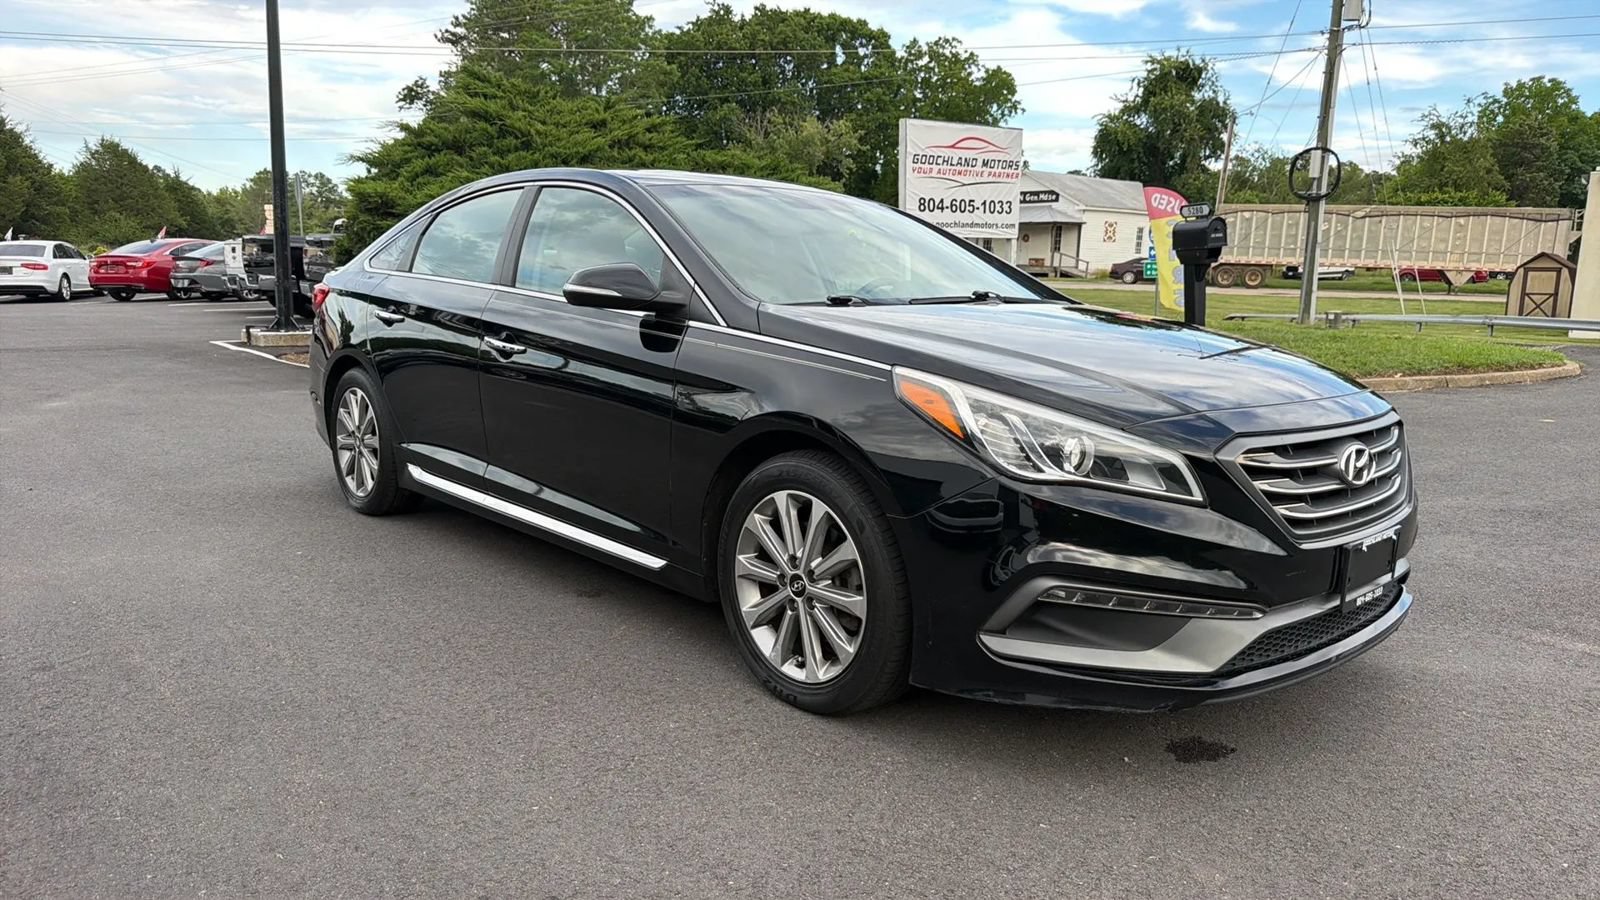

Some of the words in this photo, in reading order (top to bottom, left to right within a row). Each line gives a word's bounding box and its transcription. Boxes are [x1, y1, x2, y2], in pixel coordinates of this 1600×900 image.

[912, 154, 977, 168] GOOCHLAND
[981, 158, 1020, 170] MOTORS
[912, 166, 934, 175] YOUR
[936, 167, 985, 177] AUTOMOTIVE
[987, 171, 1020, 180] PARTNER
[918, 197, 1013, 215] 804-605-1033
